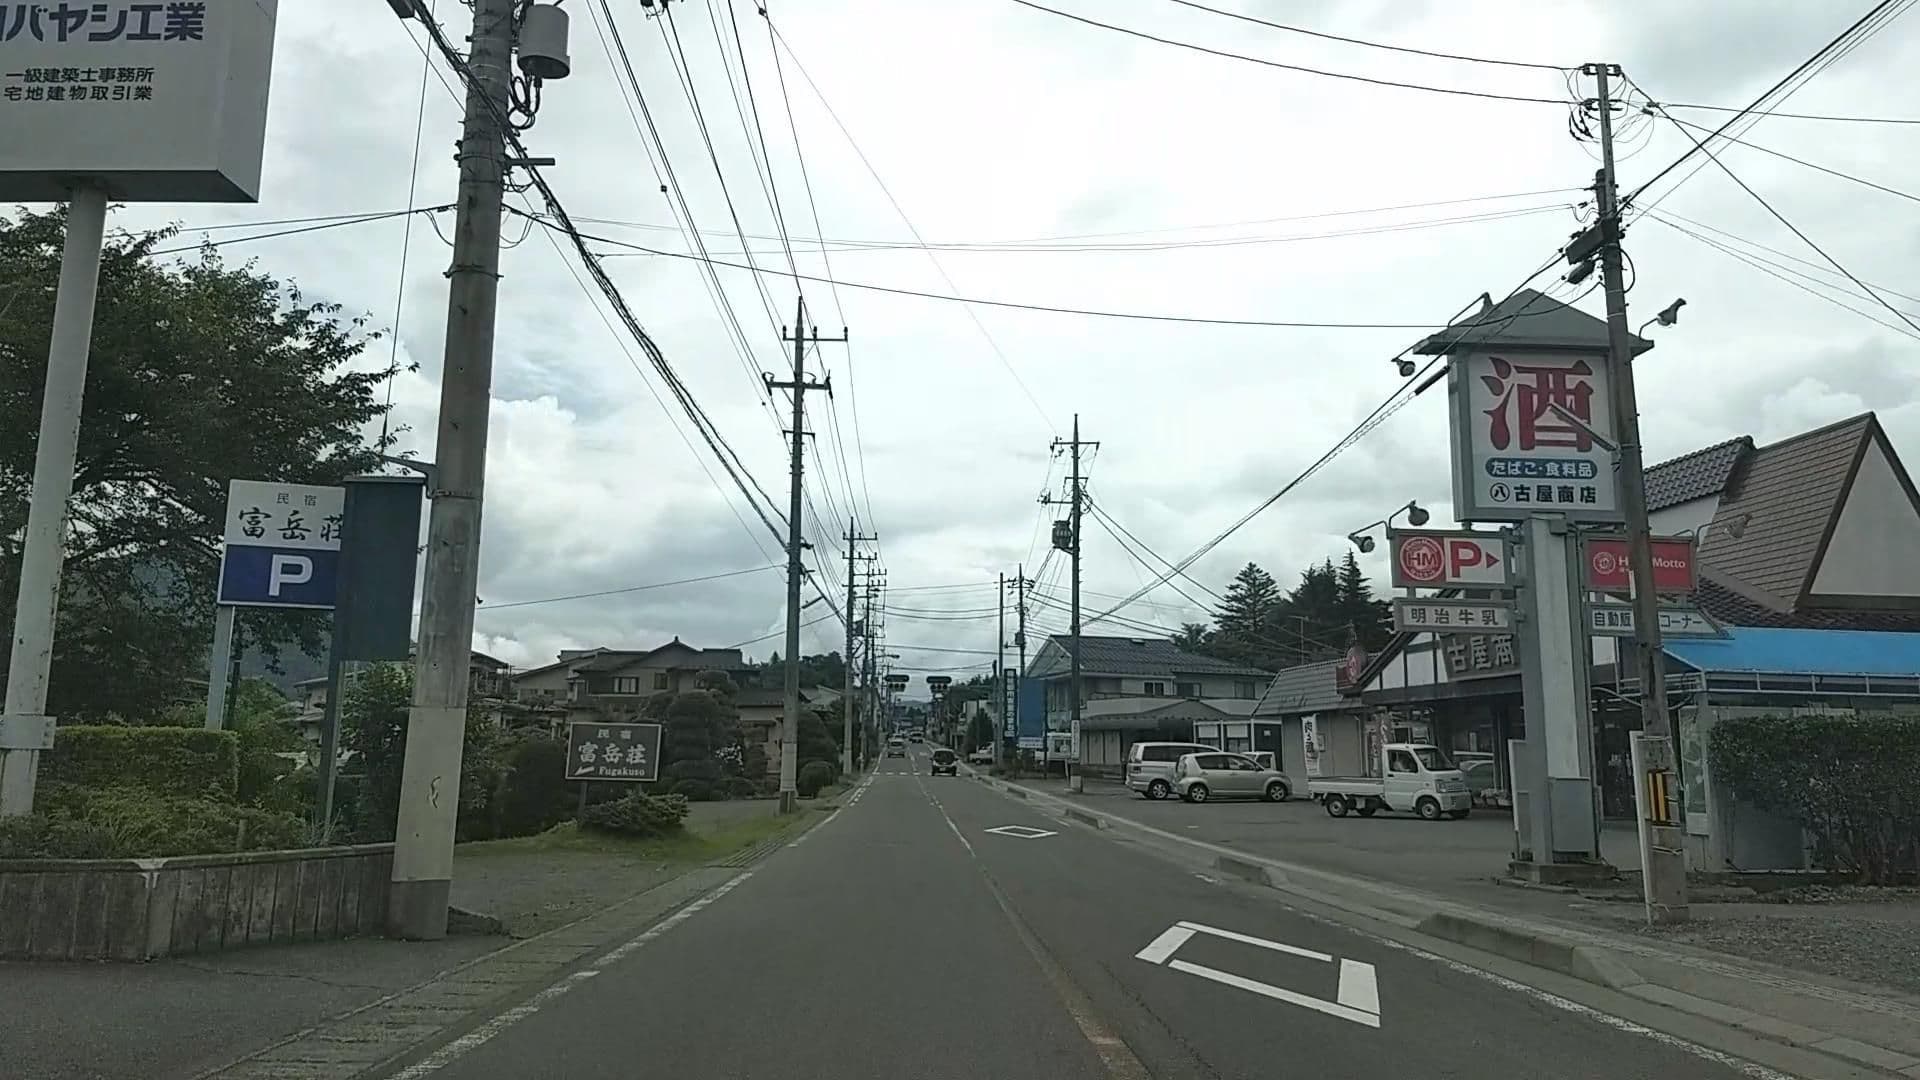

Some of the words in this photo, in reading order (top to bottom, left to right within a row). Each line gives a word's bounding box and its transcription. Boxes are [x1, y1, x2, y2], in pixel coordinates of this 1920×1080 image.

[0, 2, 205, 41] バヤシ工業
[6, 67, 154, 83] 一級建築士事務所
[4, 86, 153, 101] 宅地建物取引業
[1480, 356, 1594, 452] 酒
[276, 492, 317, 506] 民宿
[238, 507, 343, 542] 富岳荘
[1407, 550, 1437, 567] HM
[1450, 541, 1481, 577] P
[1652, 557, 1686, 569] Motto
[268, 554, 313, 597] P
[1411, 608, 1499, 625] 明治牛乳
[578, 741, 646, 765] 富岳荘
